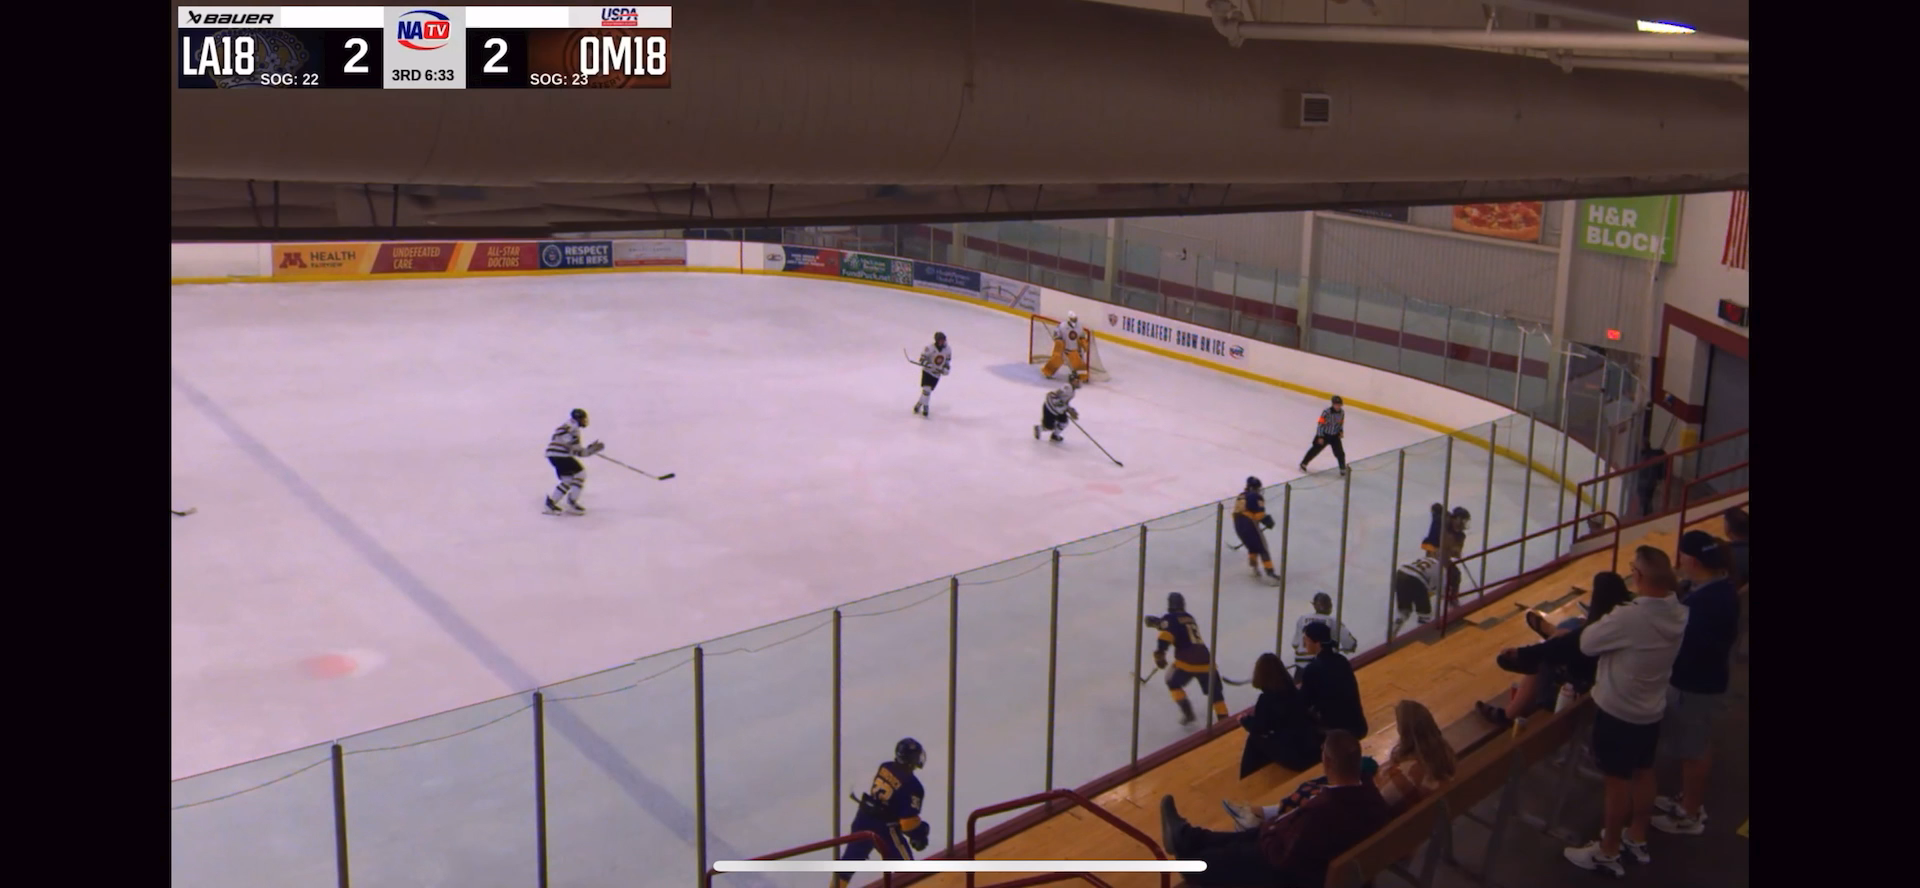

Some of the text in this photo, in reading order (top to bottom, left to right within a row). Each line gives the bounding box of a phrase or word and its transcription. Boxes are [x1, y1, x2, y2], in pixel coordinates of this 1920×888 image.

[1588, 204, 1638, 228] H&R
[1586, 225, 1666, 255] BLOCK
[310, 251, 356, 261] HEALTH
[392, 247, 440, 258] UNDEFEATED
[487, 246, 520, 257] ALL-STAR
[565, 245, 609, 256] RESPECT
[393, 258, 413, 269] CARE
[487, 257, 520, 267] DOCTORS
[566, 255, 609, 265] THE REFS
[1122, 315, 1135, 333] THE
[1137, 319, 1172, 343] GREATEST
[1176, 329, 1198, 350] SHOW
[1200, 335, 1211, 352] ON
[1213, 339, 1225, 356] ICE
